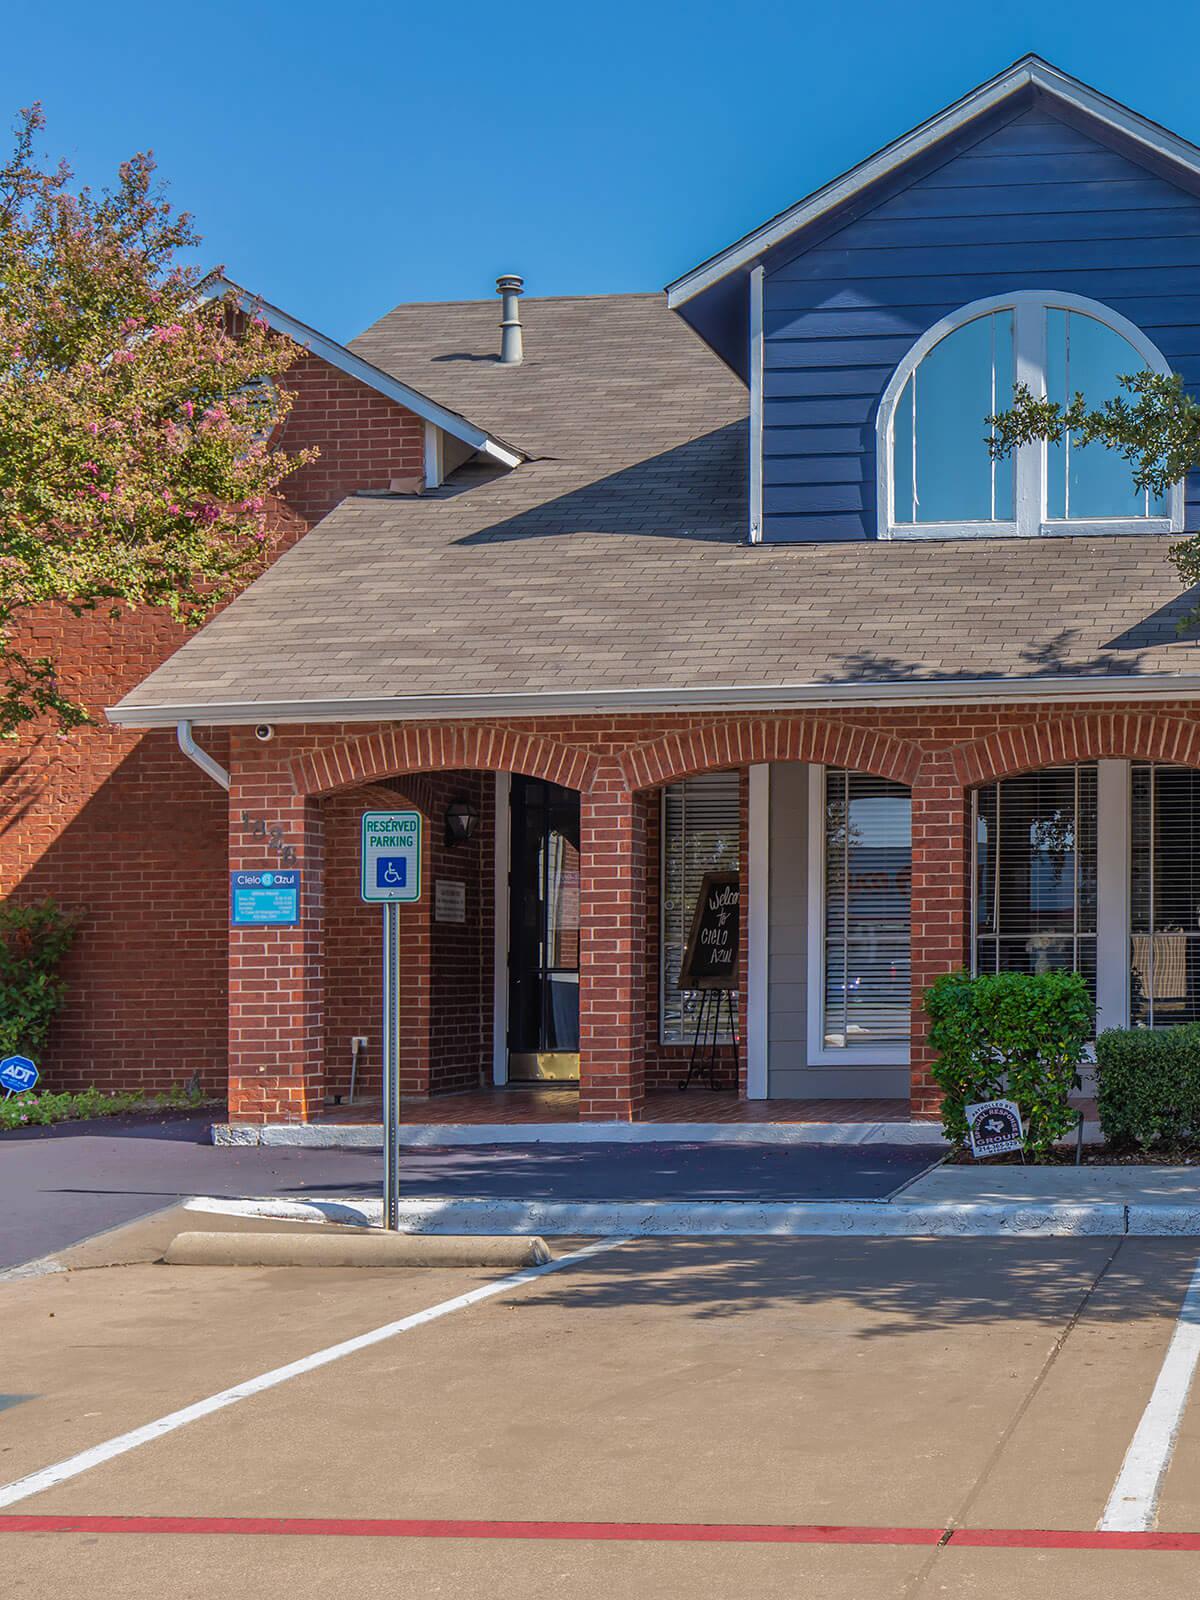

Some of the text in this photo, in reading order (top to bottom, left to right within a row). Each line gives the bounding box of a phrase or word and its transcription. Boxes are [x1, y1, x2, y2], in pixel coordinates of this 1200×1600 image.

[367, 820, 417, 832] RESERVED
[370, 836, 413, 847] PARKING
[237, 874, 295, 885] Cielo Azul
[716, 907, 732, 926] to
[2, 1064, 35, 1083] ADT
[976, 1133, 1019, 1146] GROUP
